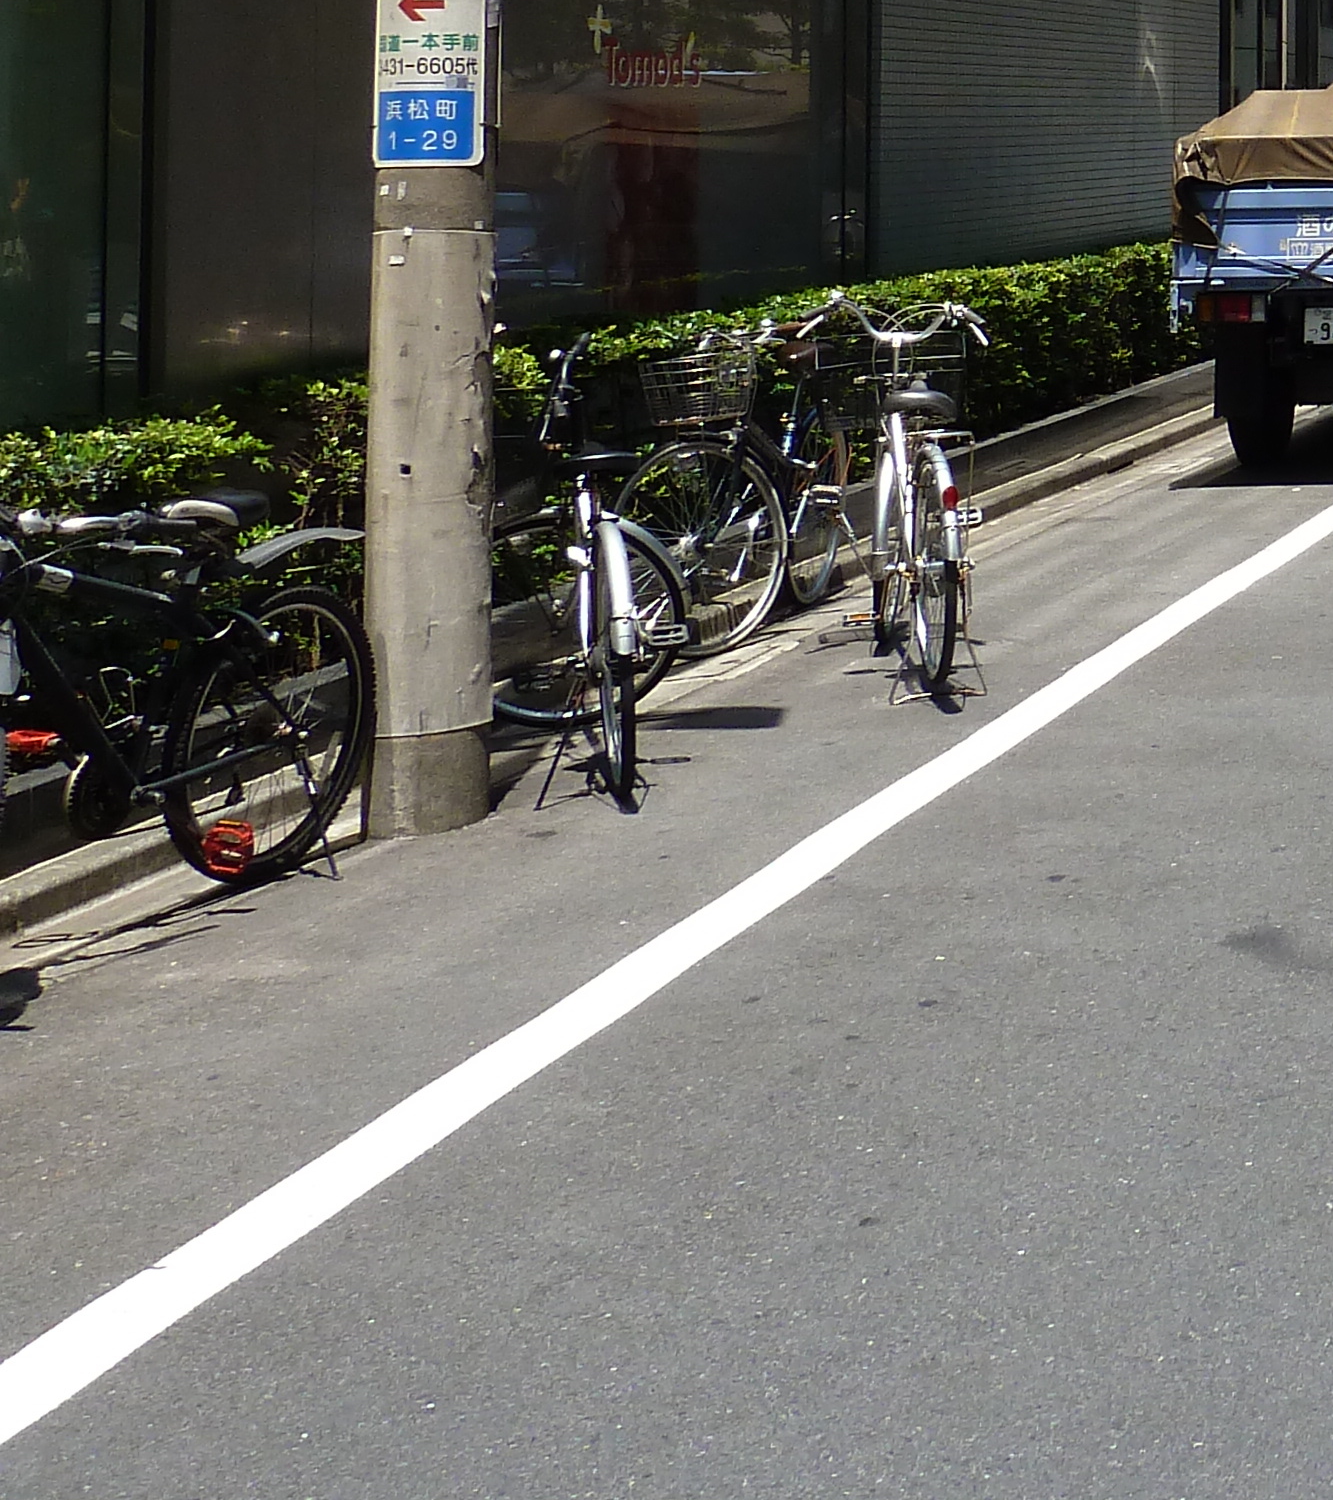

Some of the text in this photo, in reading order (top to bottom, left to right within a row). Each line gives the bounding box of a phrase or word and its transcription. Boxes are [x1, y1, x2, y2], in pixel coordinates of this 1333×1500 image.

[385, 98, 458, 122] 浜松町
[388, 129, 459, 151] 1-29
